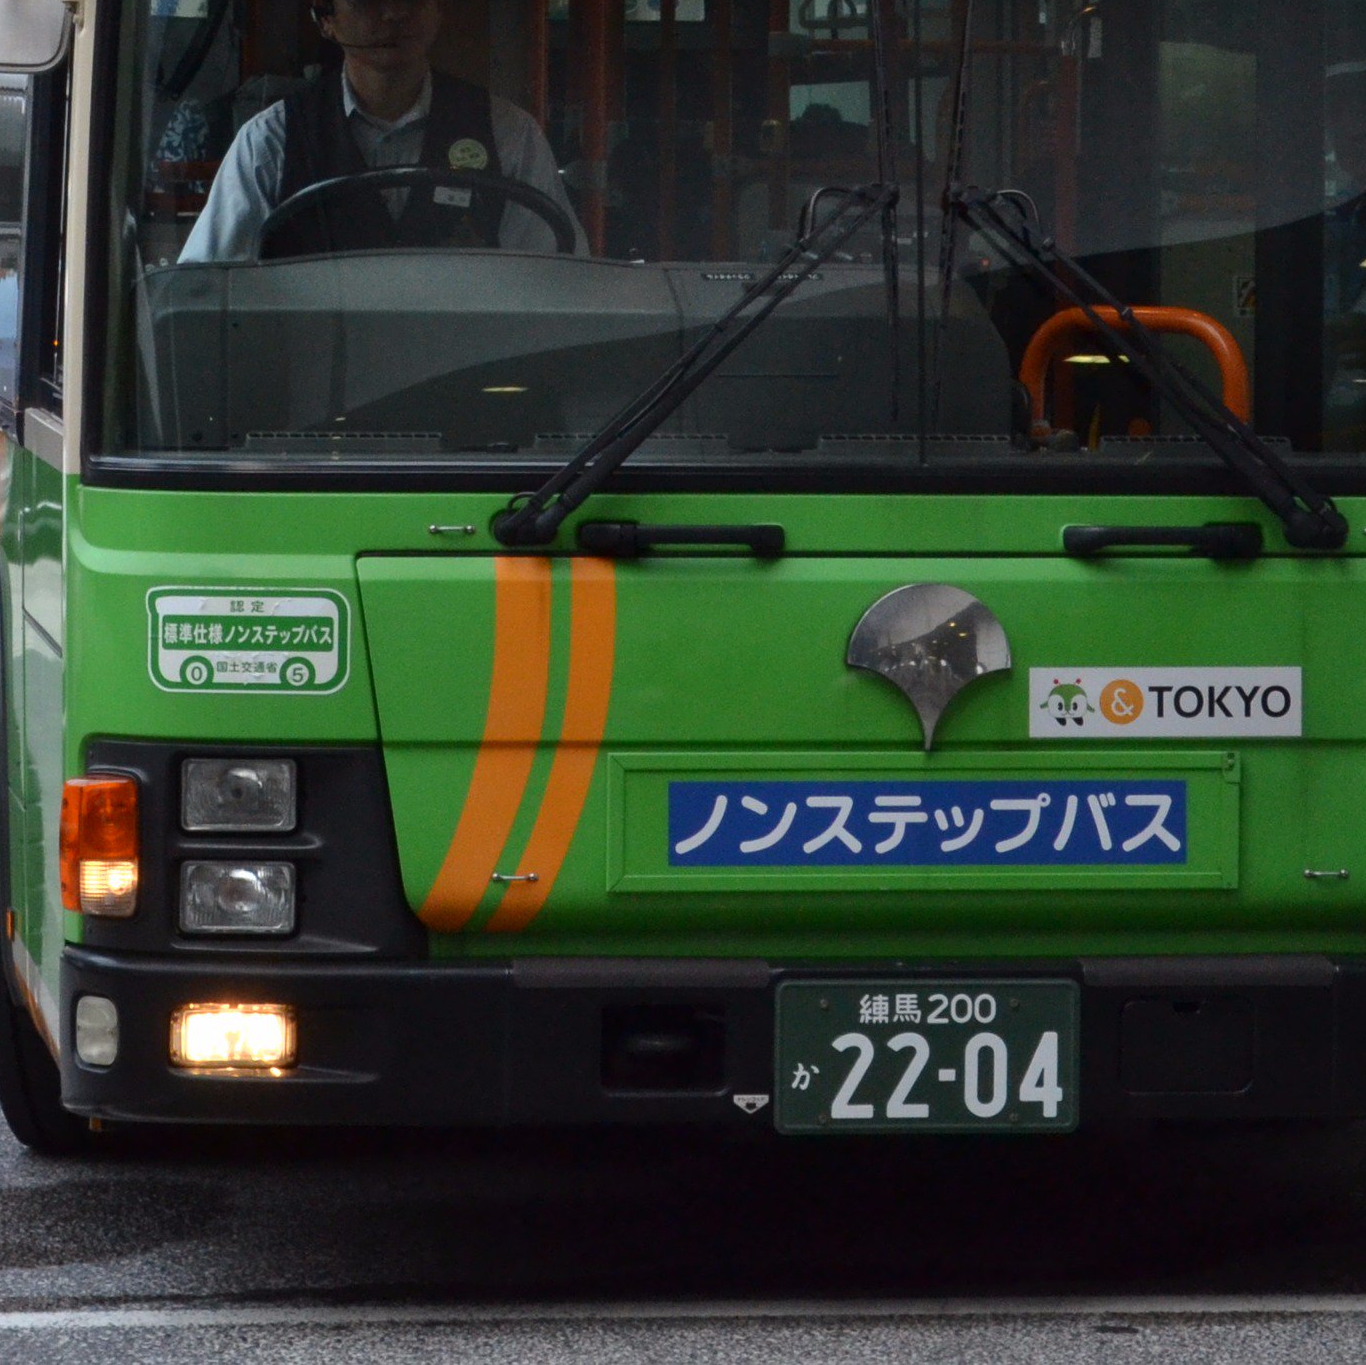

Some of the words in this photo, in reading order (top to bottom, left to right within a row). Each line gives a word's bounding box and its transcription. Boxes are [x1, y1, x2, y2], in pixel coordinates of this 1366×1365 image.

[164, 622, 332, 645] 標準仕様ノンステップバス
[216, 661, 278, 674] 国土交通省
[1149, 686, 1290, 718] TOKYO
[675, 792, 1181, 854] ノンステップバス
[792, 1063, 820, 1090] か
[831, 1031, 1063, 1119] 22-04
